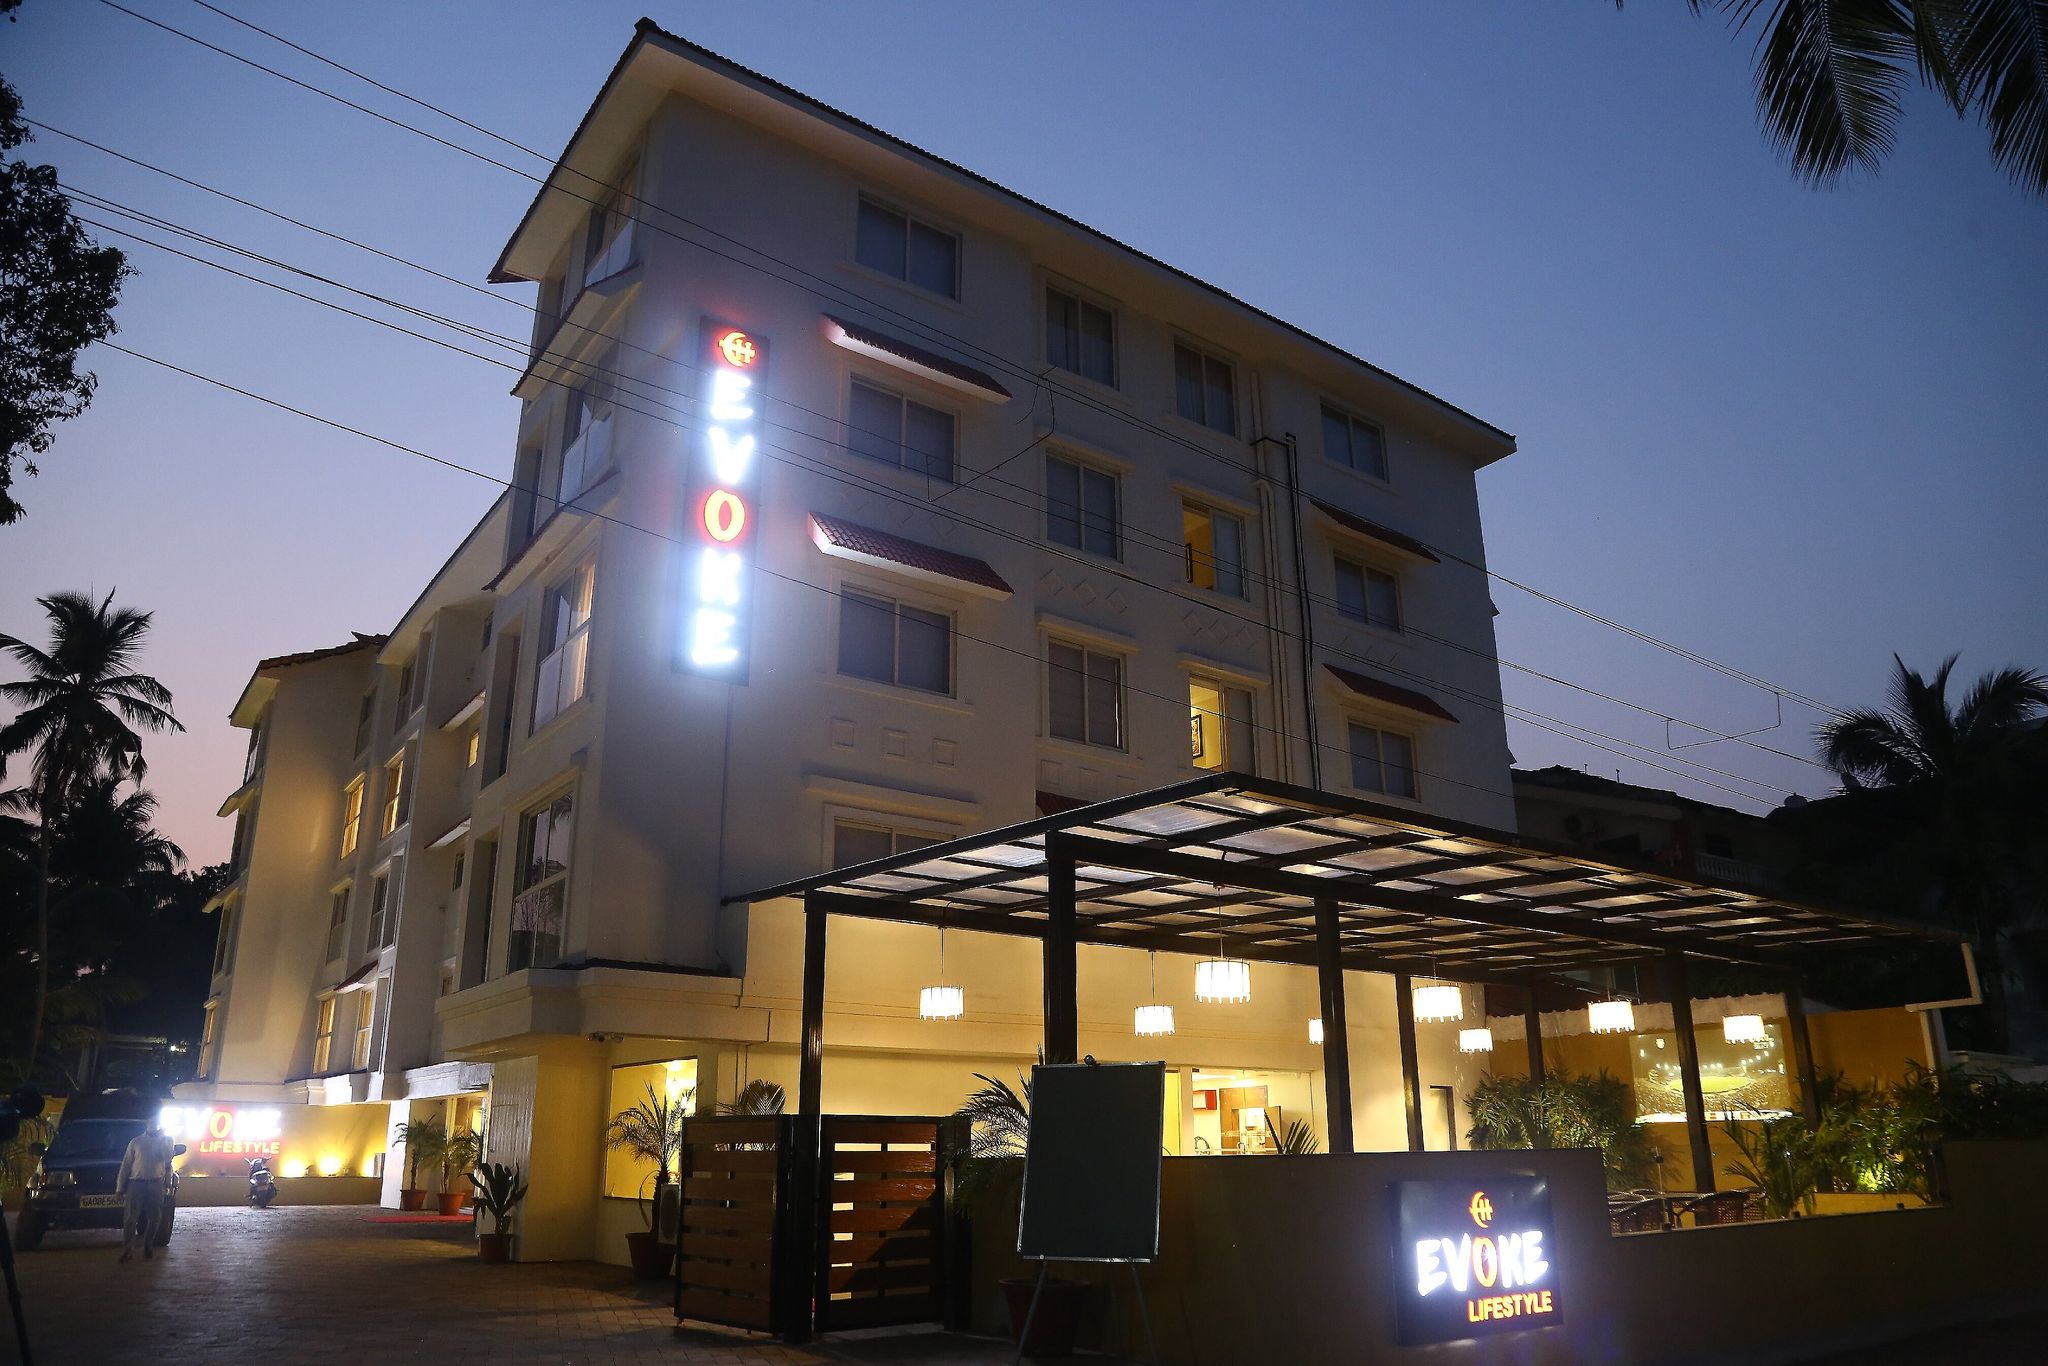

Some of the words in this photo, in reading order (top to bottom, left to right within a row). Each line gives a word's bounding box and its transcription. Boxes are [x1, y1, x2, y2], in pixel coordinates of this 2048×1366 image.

[692, 369, 755, 664] EVOKE
[199, 1139, 281, 1154] LIFESTYLE
[1416, 1231, 1549, 1296] EVOKE
[1468, 1291, 1552, 1322] LIFESTYLE
